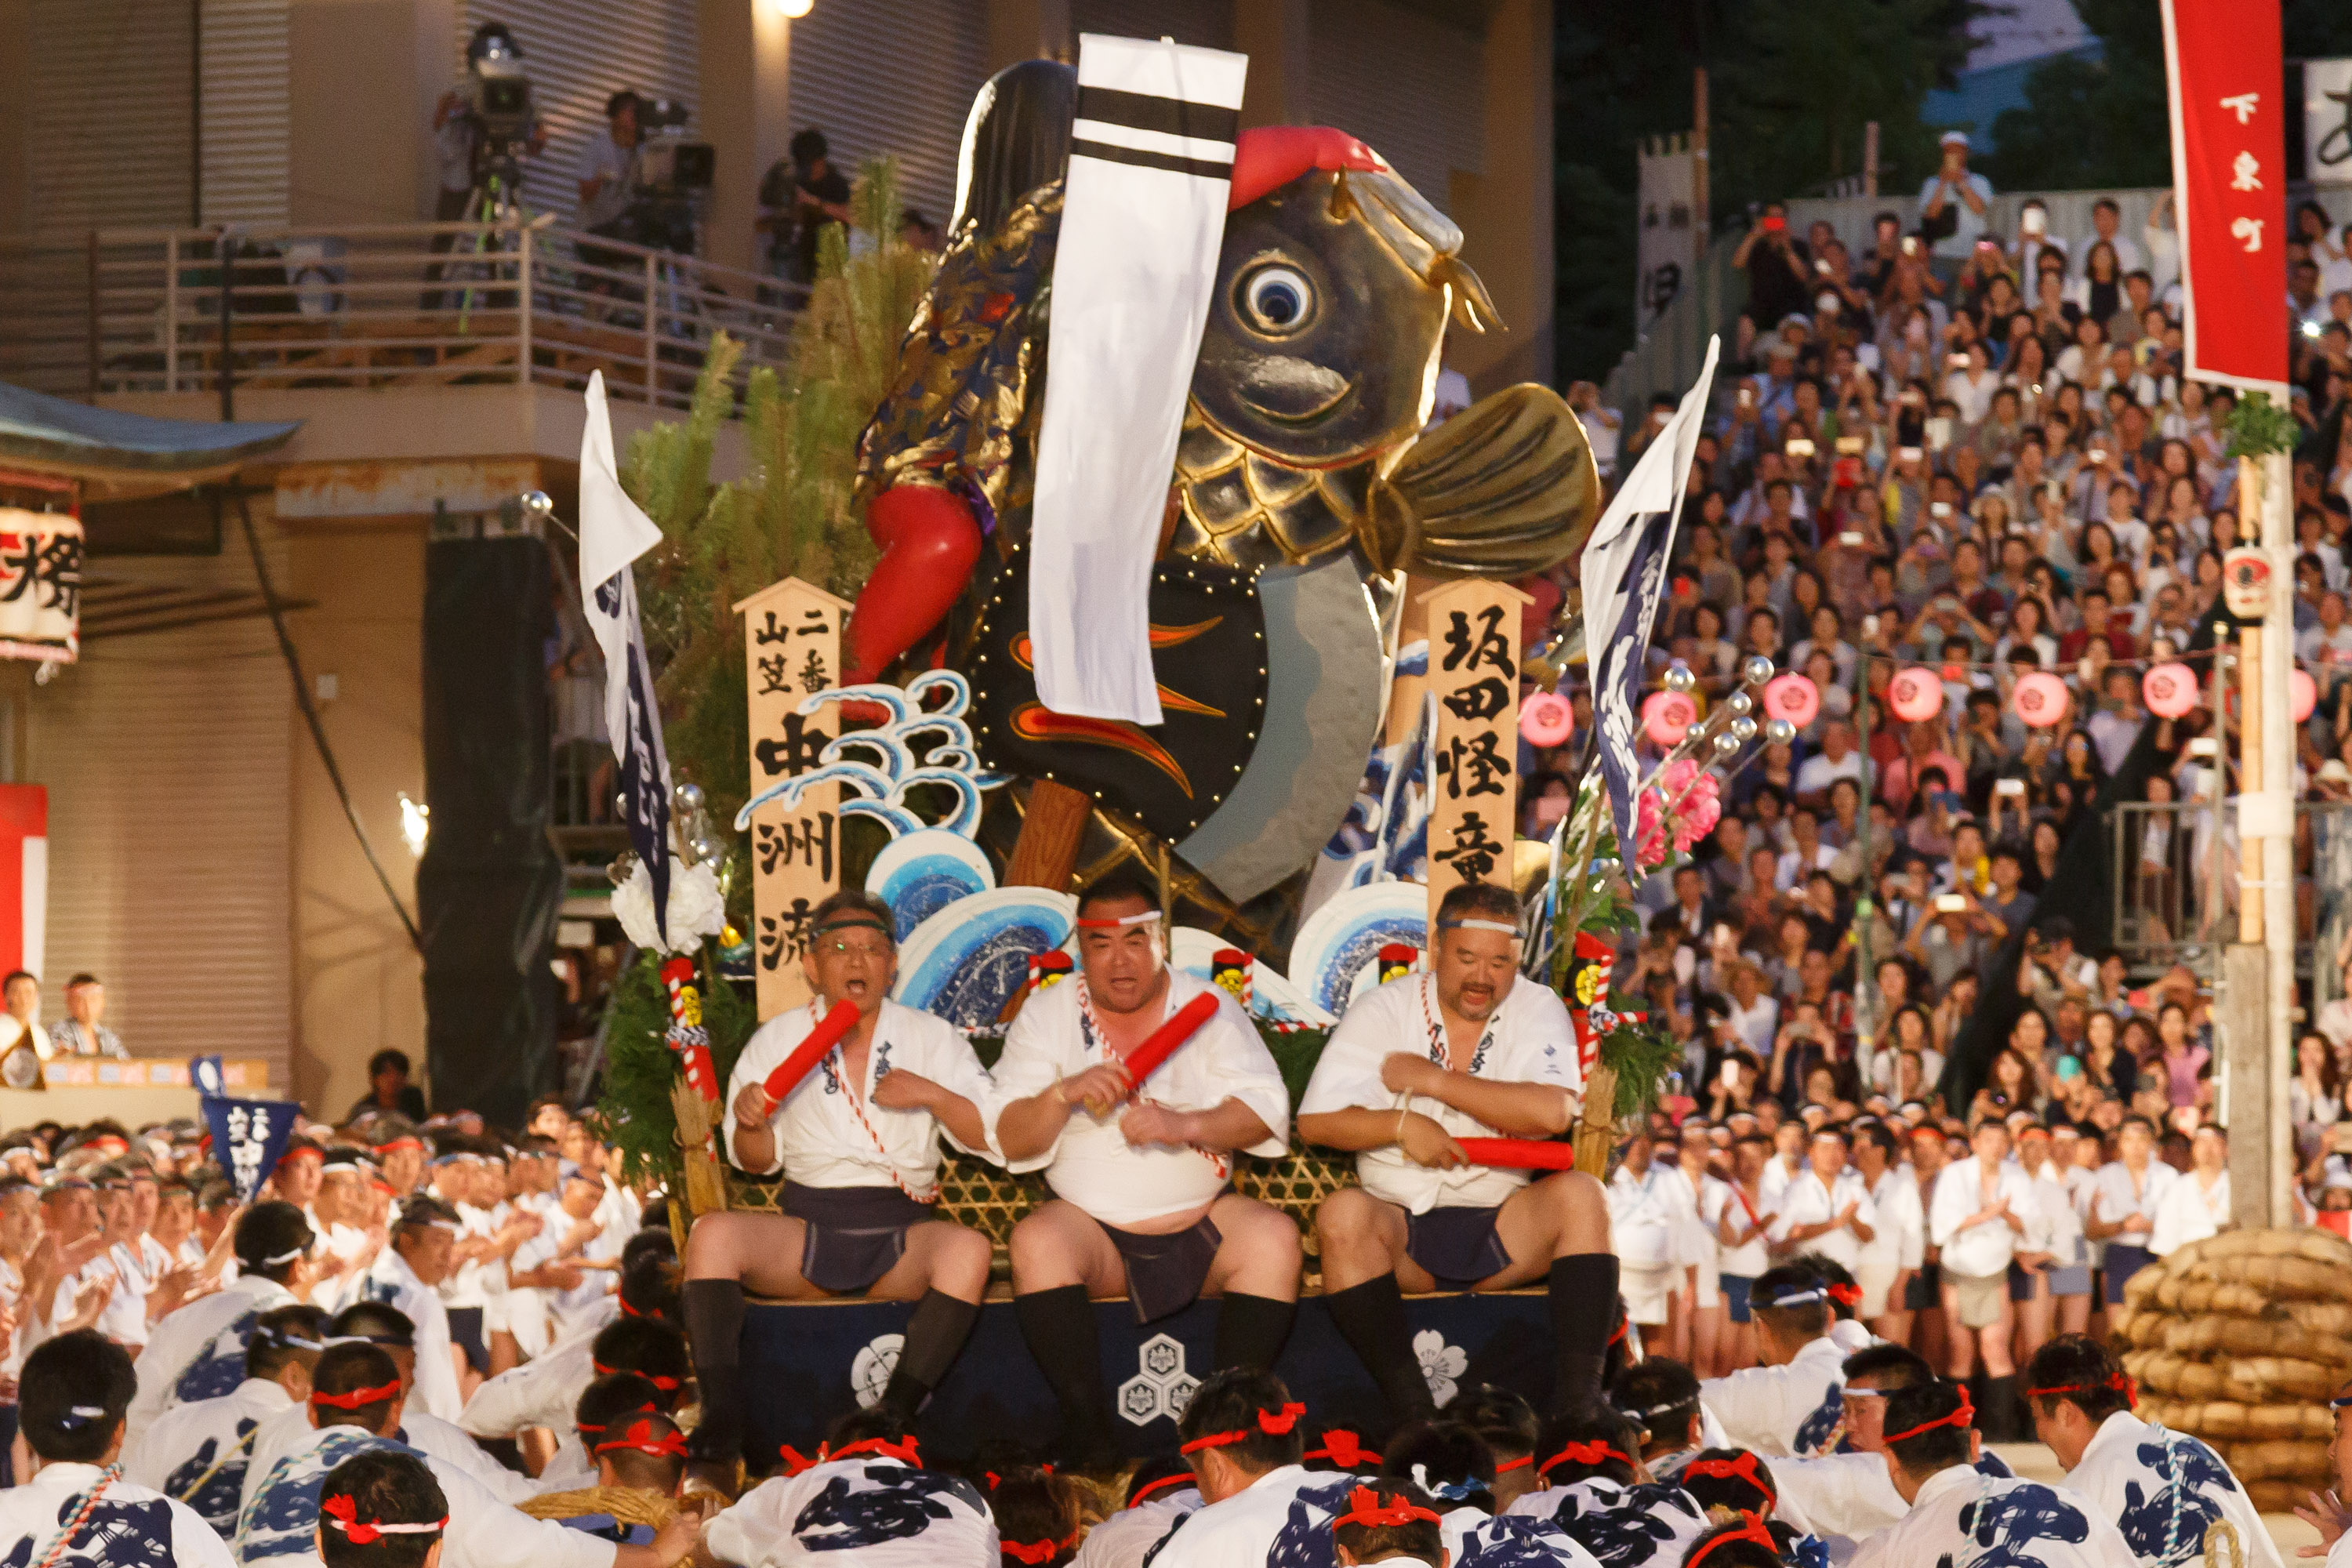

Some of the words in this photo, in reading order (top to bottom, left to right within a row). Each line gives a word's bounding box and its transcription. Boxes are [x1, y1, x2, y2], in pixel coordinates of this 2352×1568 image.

[756, 610, 793, 696] 山笠
[796, 608, 833, 694] 二番
[754, 711, 836, 971] 中洲流
